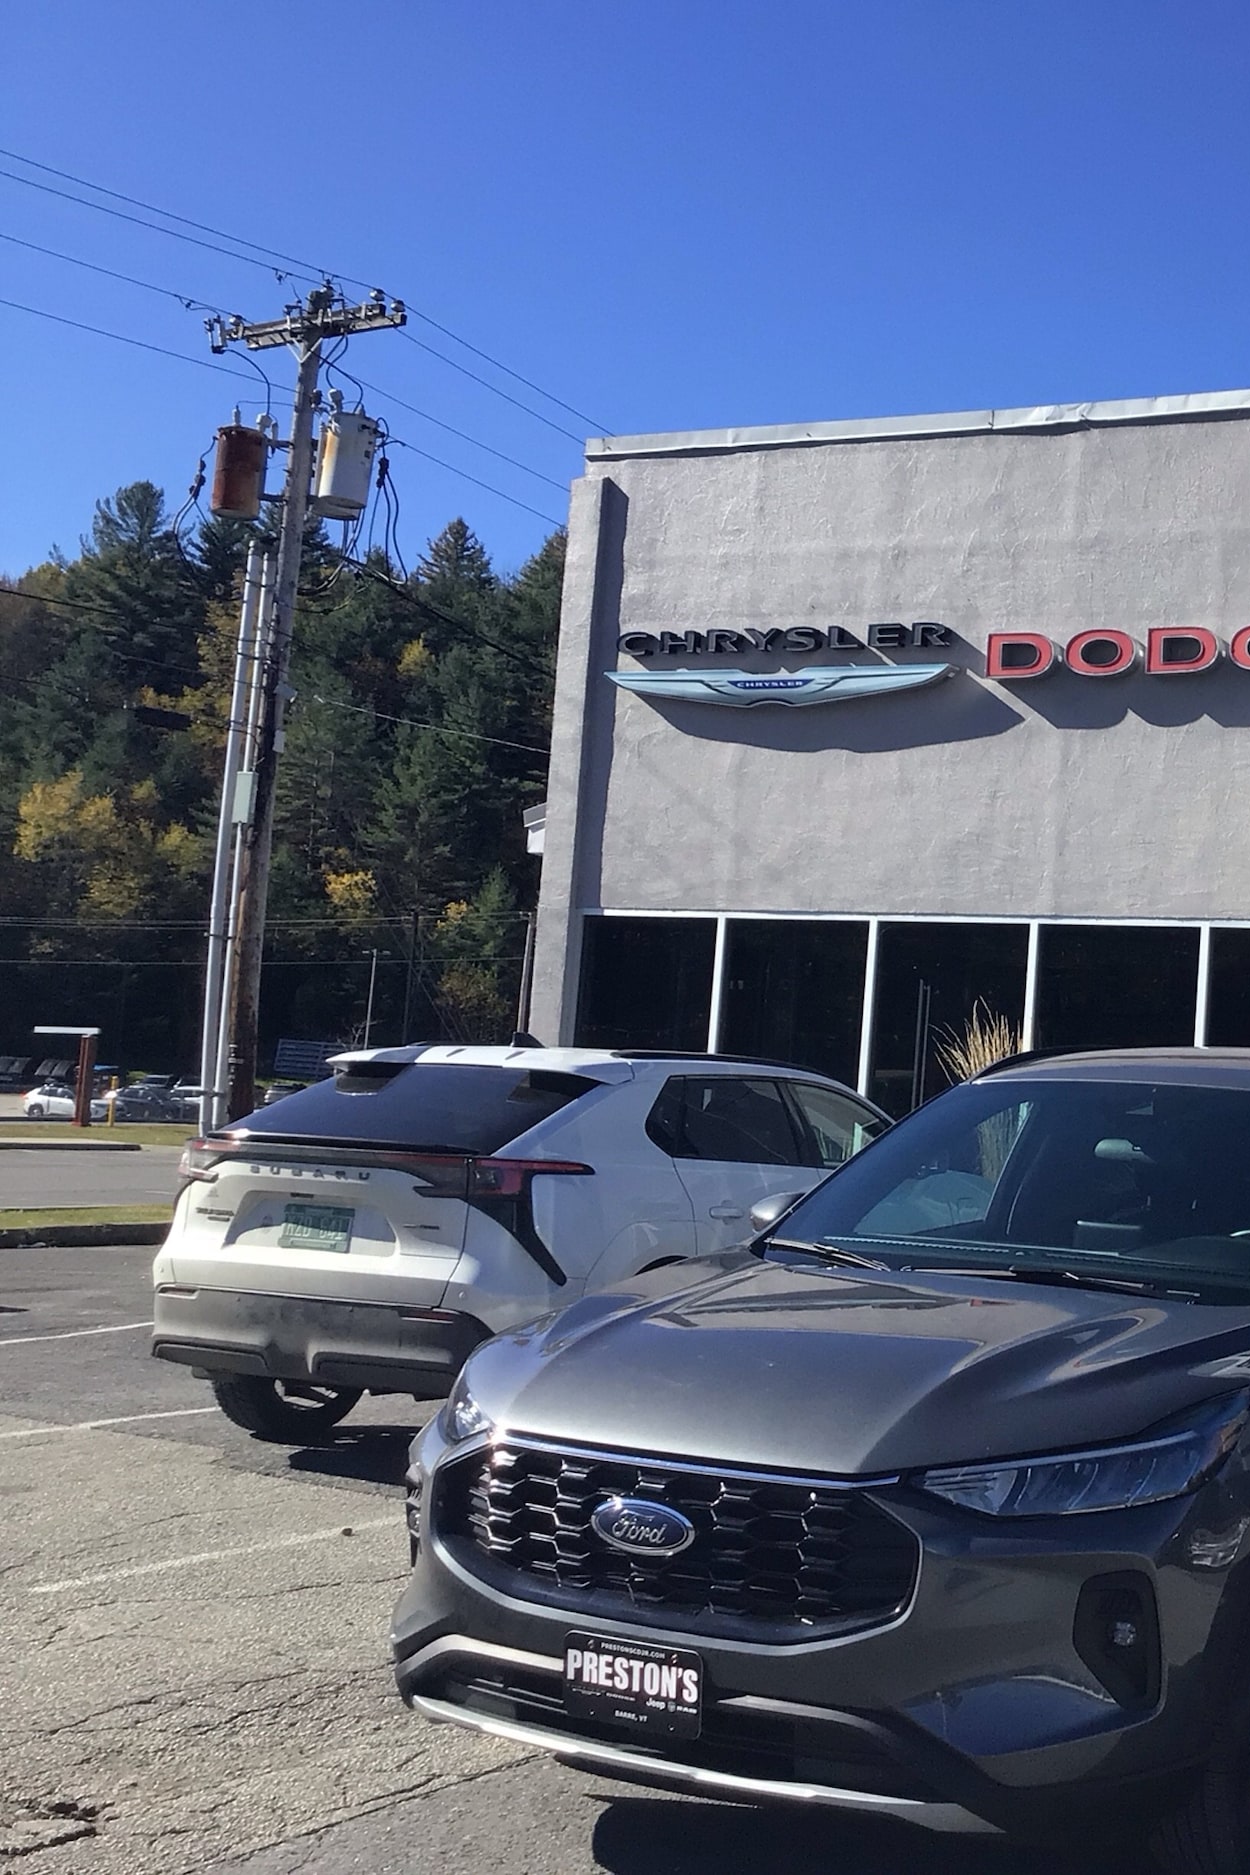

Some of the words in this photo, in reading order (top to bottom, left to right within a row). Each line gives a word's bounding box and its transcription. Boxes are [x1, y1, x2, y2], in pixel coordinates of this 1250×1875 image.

[617, 622, 950, 656] CHRYSLER
[737, 680, 803, 688] CHRYSLER
[250, 1164, 371, 1181] SUBARU
[612, 1508, 668, 1544] Ford
[567, 1648, 698, 1704] PRESTON'S
